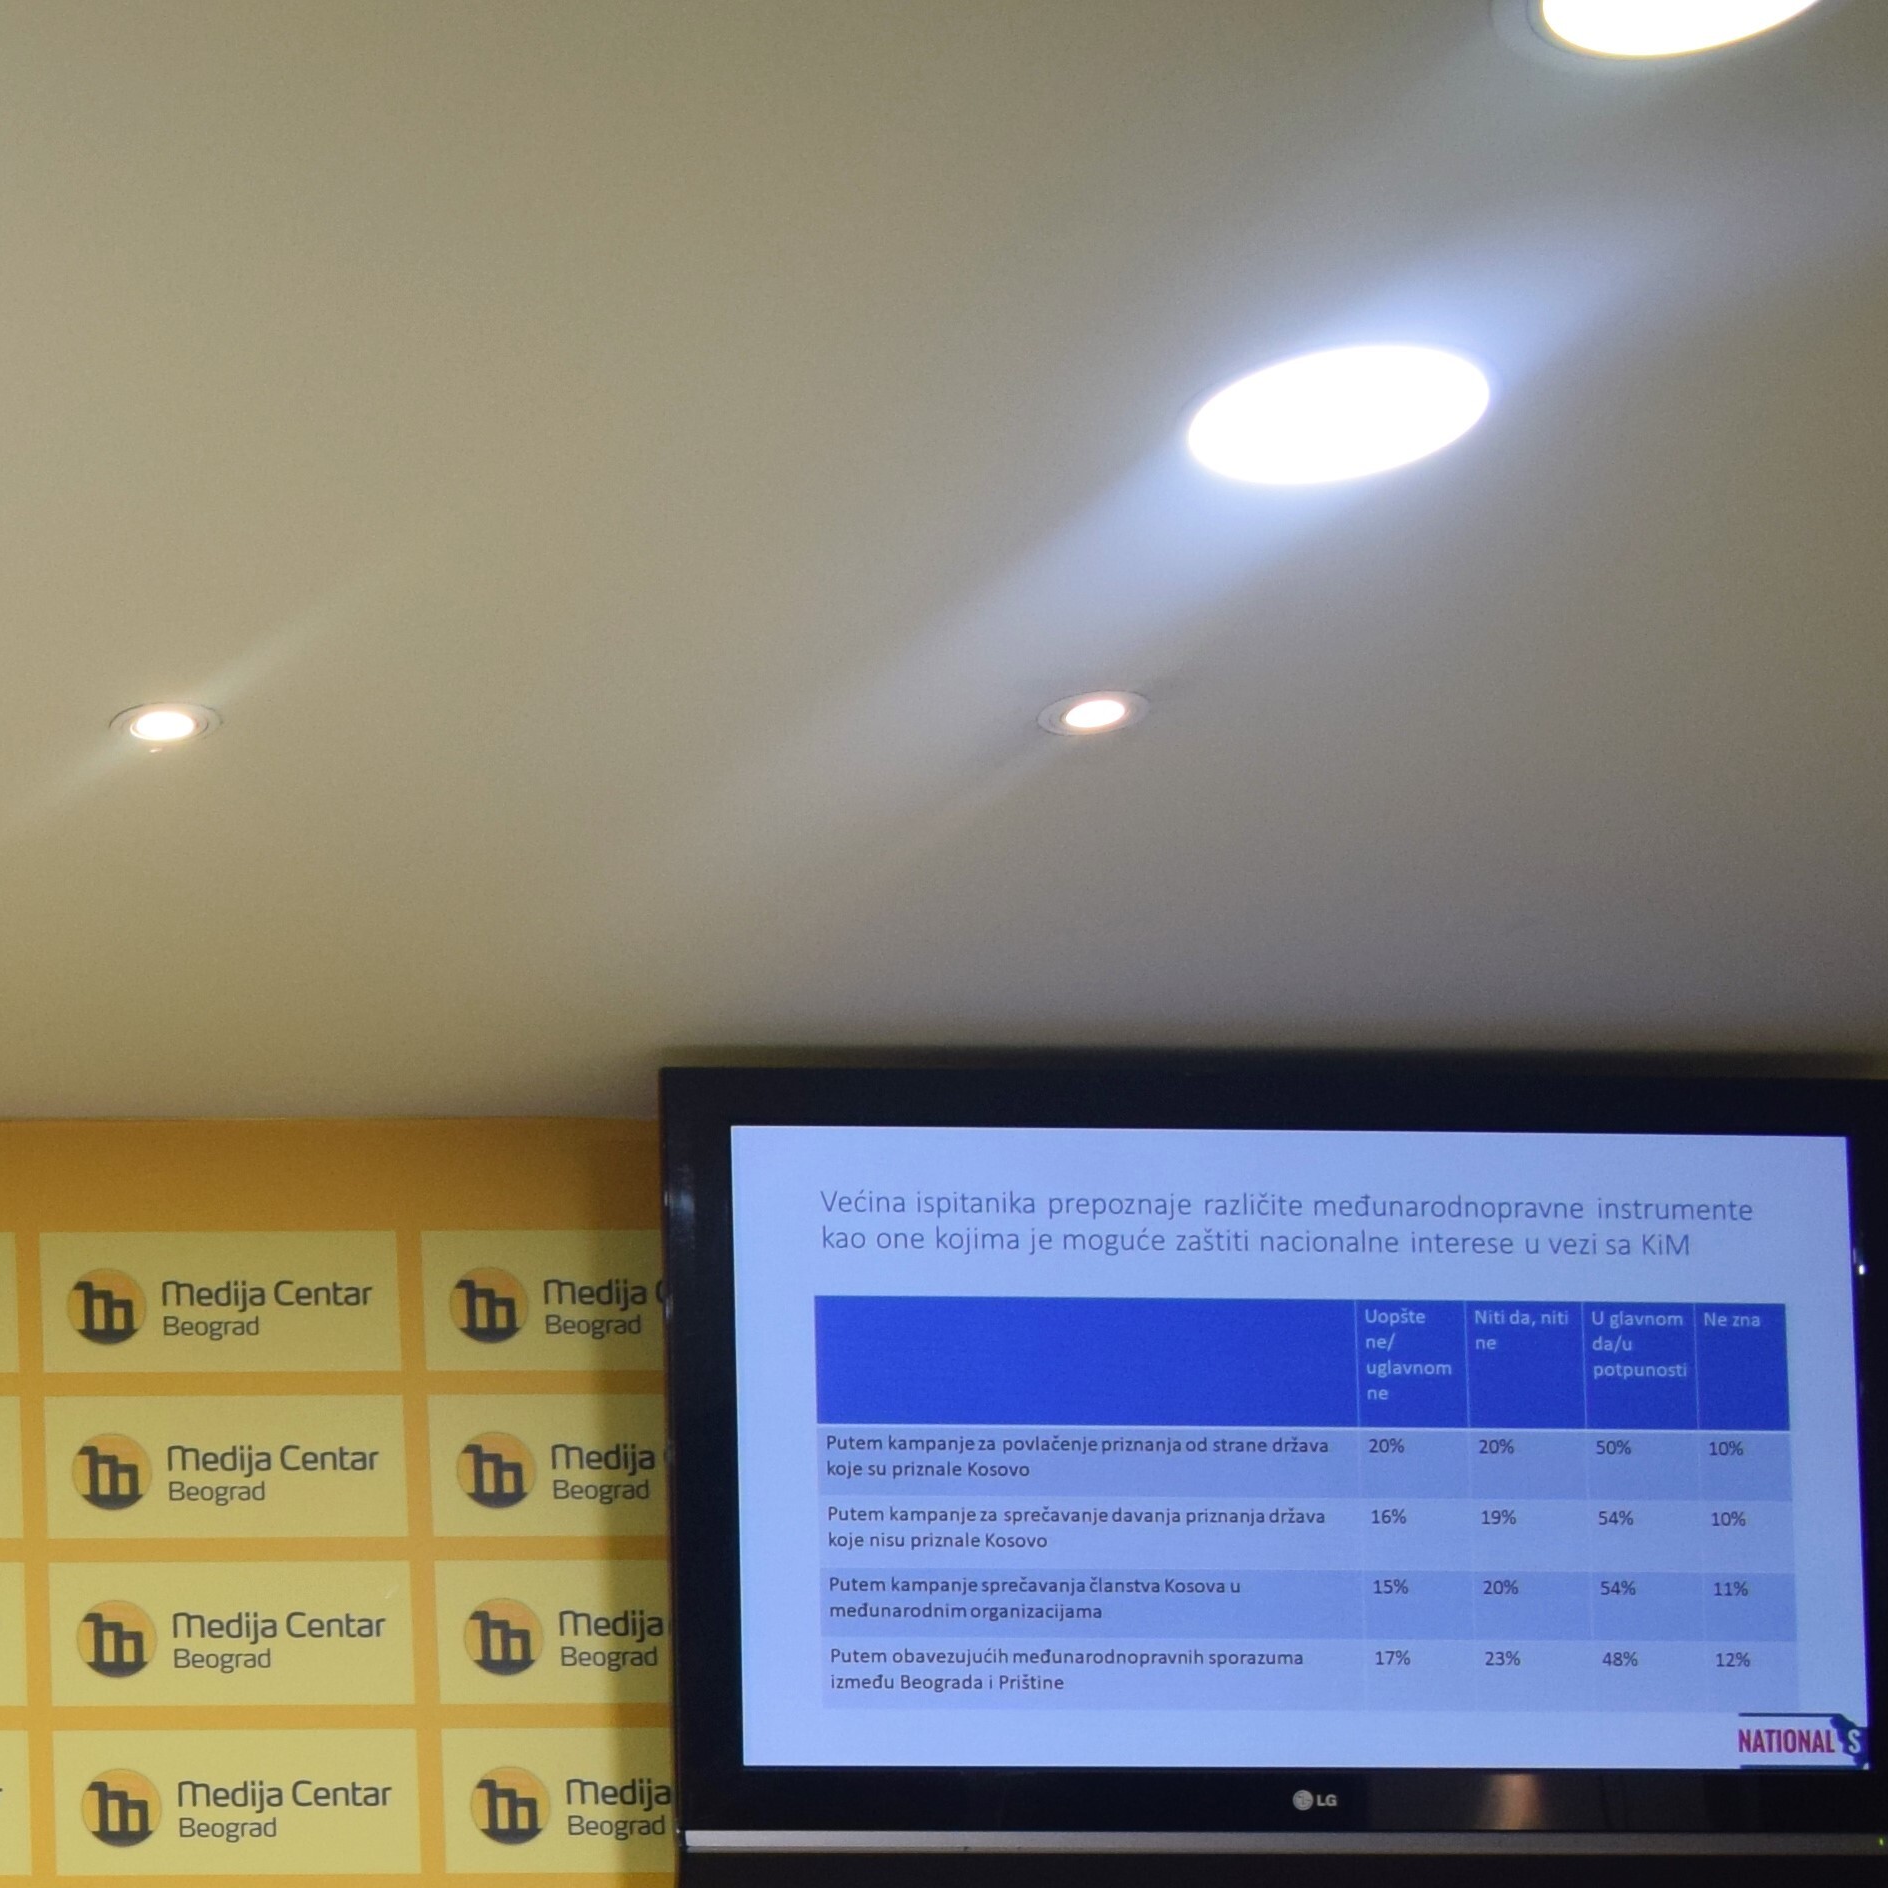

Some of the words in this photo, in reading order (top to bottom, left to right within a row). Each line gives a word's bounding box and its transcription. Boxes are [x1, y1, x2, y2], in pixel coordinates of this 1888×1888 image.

[820, 1189, 906, 1213] Većina
[917, 1190, 1036, 1218] ispitanika
[1048, 1197, 1192, 1221] prepoznaje
[1204, 1192, 1303, 1217] različite
[1313, 1193, 1585, 1224] međunarodnopravne
[1597, 1196, 1755, 1223] instrumente
[822, 1225, 866, 1249] kao
[876, 1232, 925, 1250] one
[935, 1225, 1020, 1255] kojima
[1029, 1233, 1053, 1256] je
[1063, 1227, 1166, 1257] moguće
[1176, 1228, 1249, 1252] zaštiti
[1260, 1229, 1400, 1254] nacionalne
[1411, 1231, 1515, 1255] interese
[1524, 1237, 1540, 1255] u
[1547, 1232, 1598, 1256] vezi
[1605, 1237, 1632, 1257] sa
[1641, 1232, 1693, 1257] KiM
[1364, 1307, 1426, 1327] Uopšte
[1474, 1309, 1506, 1325] Niti
[1508, 1309, 1536, 1327] da,
[1540, 1310, 1569, 1326] niti
[1591, 1310, 1605, 1326] U
[1609, 1310, 1684, 1330] glavnom
[1703, 1311, 1728, 1327] Ne
[1732, 1315, 1761, 1328] zna
[1365, 1331, 1396, 1352] ne/
[1475, 1338, 1498, 1351] ne
[1591, 1334, 1633, 1354] da/u
[1366, 1359, 1453, 1379] uglavnom
[1593, 1363, 1688, 1380] potpunosti
[1366, 1388, 1389, 1401] ne
[826, 1435, 883, 1451] Putem
[888, 1434, 976, 1455] kampanje
[978, 1439, 996, 1451] za
[1002, 1435, 1099, 1455] povlačenje
[1101, 1436, 1182, 1456] priznanja
[1185, 1436, 1208, 1453] od
[1212, 1438, 1268, 1453] strane
[1271, 1436, 1329, 1454] država
[1368, 1437, 1405, 1454] 20%
[1478, 1438, 1515, 1455] 20%
[1596, 1439, 1633, 1456] 50%
[1709, 1440, 1745, 1457] 10%
[167, 1444, 272, 1478] Medija
[279, 1444, 380, 1472] Centar
[826, 1460, 863, 1480] koje
[867, 1464, 887, 1477] su
[892, 1460, 963, 1480] priznale
[967, 1461, 1031, 1477] Kosovo
[168, 1480, 266, 1507] Beograd
[828, 1506, 885, 1522] Putem
[889, 1506, 977, 1525] kampanje
[979, 1510, 998, 1522] za
[1003, 1505, 1109, 1526] sprečavanje
[1111, 1507, 1181, 1527] davanja
[1185, 1511, 1266, 1527] priznanja
[1268, 1507, 1326, 1525] država
[1371, 1508, 1408, 1525] 16%
[1481, 1509, 1517, 1526] 19%
[1598, 1509, 1635, 1526] 54%
[1711, 1510, 1747, 1527] 10%
[828, 1531, 865, 1551] koje
[869, 1535, 906, 1548] nisu
[910, 1531, 981, 1551] priznale
[985, 1532, 1048, 1549] Kosovo
[829, 1576, 886, 1592] Putem
[891, 1576, 979, 1596] kampanje
[981, 1575, 1086, 1597] sprečavanja
[1088, 1575, 1161, 1594] članstva
[1164, 1578, 1226, 1594] Kosova
[1229, 1582, 1241, 1594] u
[1373, 1578, 1410, 1595] 15%
[1483, 1579, 1520, 1596] 20%
[1600, 1579, 1637, 1596] 54%
[1714, 1580, 1749, 1597] 11%
[829, 1602, 968, 1618] međunarodnim
[970, 1603, 1103, 1622] organizacijama
[830, 1648, 888, 1664] Putem
[892, 1647, 1009, 1667] obavezujućih
[1012, 1648, 1204, 1668] međunarodnopravnih
[1208, 1652, 1304, 1668] sporazuma
[1375, 1649, 1411, 1666] 17%
[1485, 1650, 1521, 1667] 23%
[1601, 1650, 1639, 1667] 48%
[1716, 1651, 1751, 1668] 12%
[831, 1673, 895, 1690] između
[900, 1673, 983, 1694] Beograda
[988, 1678, 993, 1690] i
[998, 1673, 1065, 1691] Prištine
[1737, 1728, 1836, 1754] NATIONAL
[1316, 1793, 1338, 1807] LG
